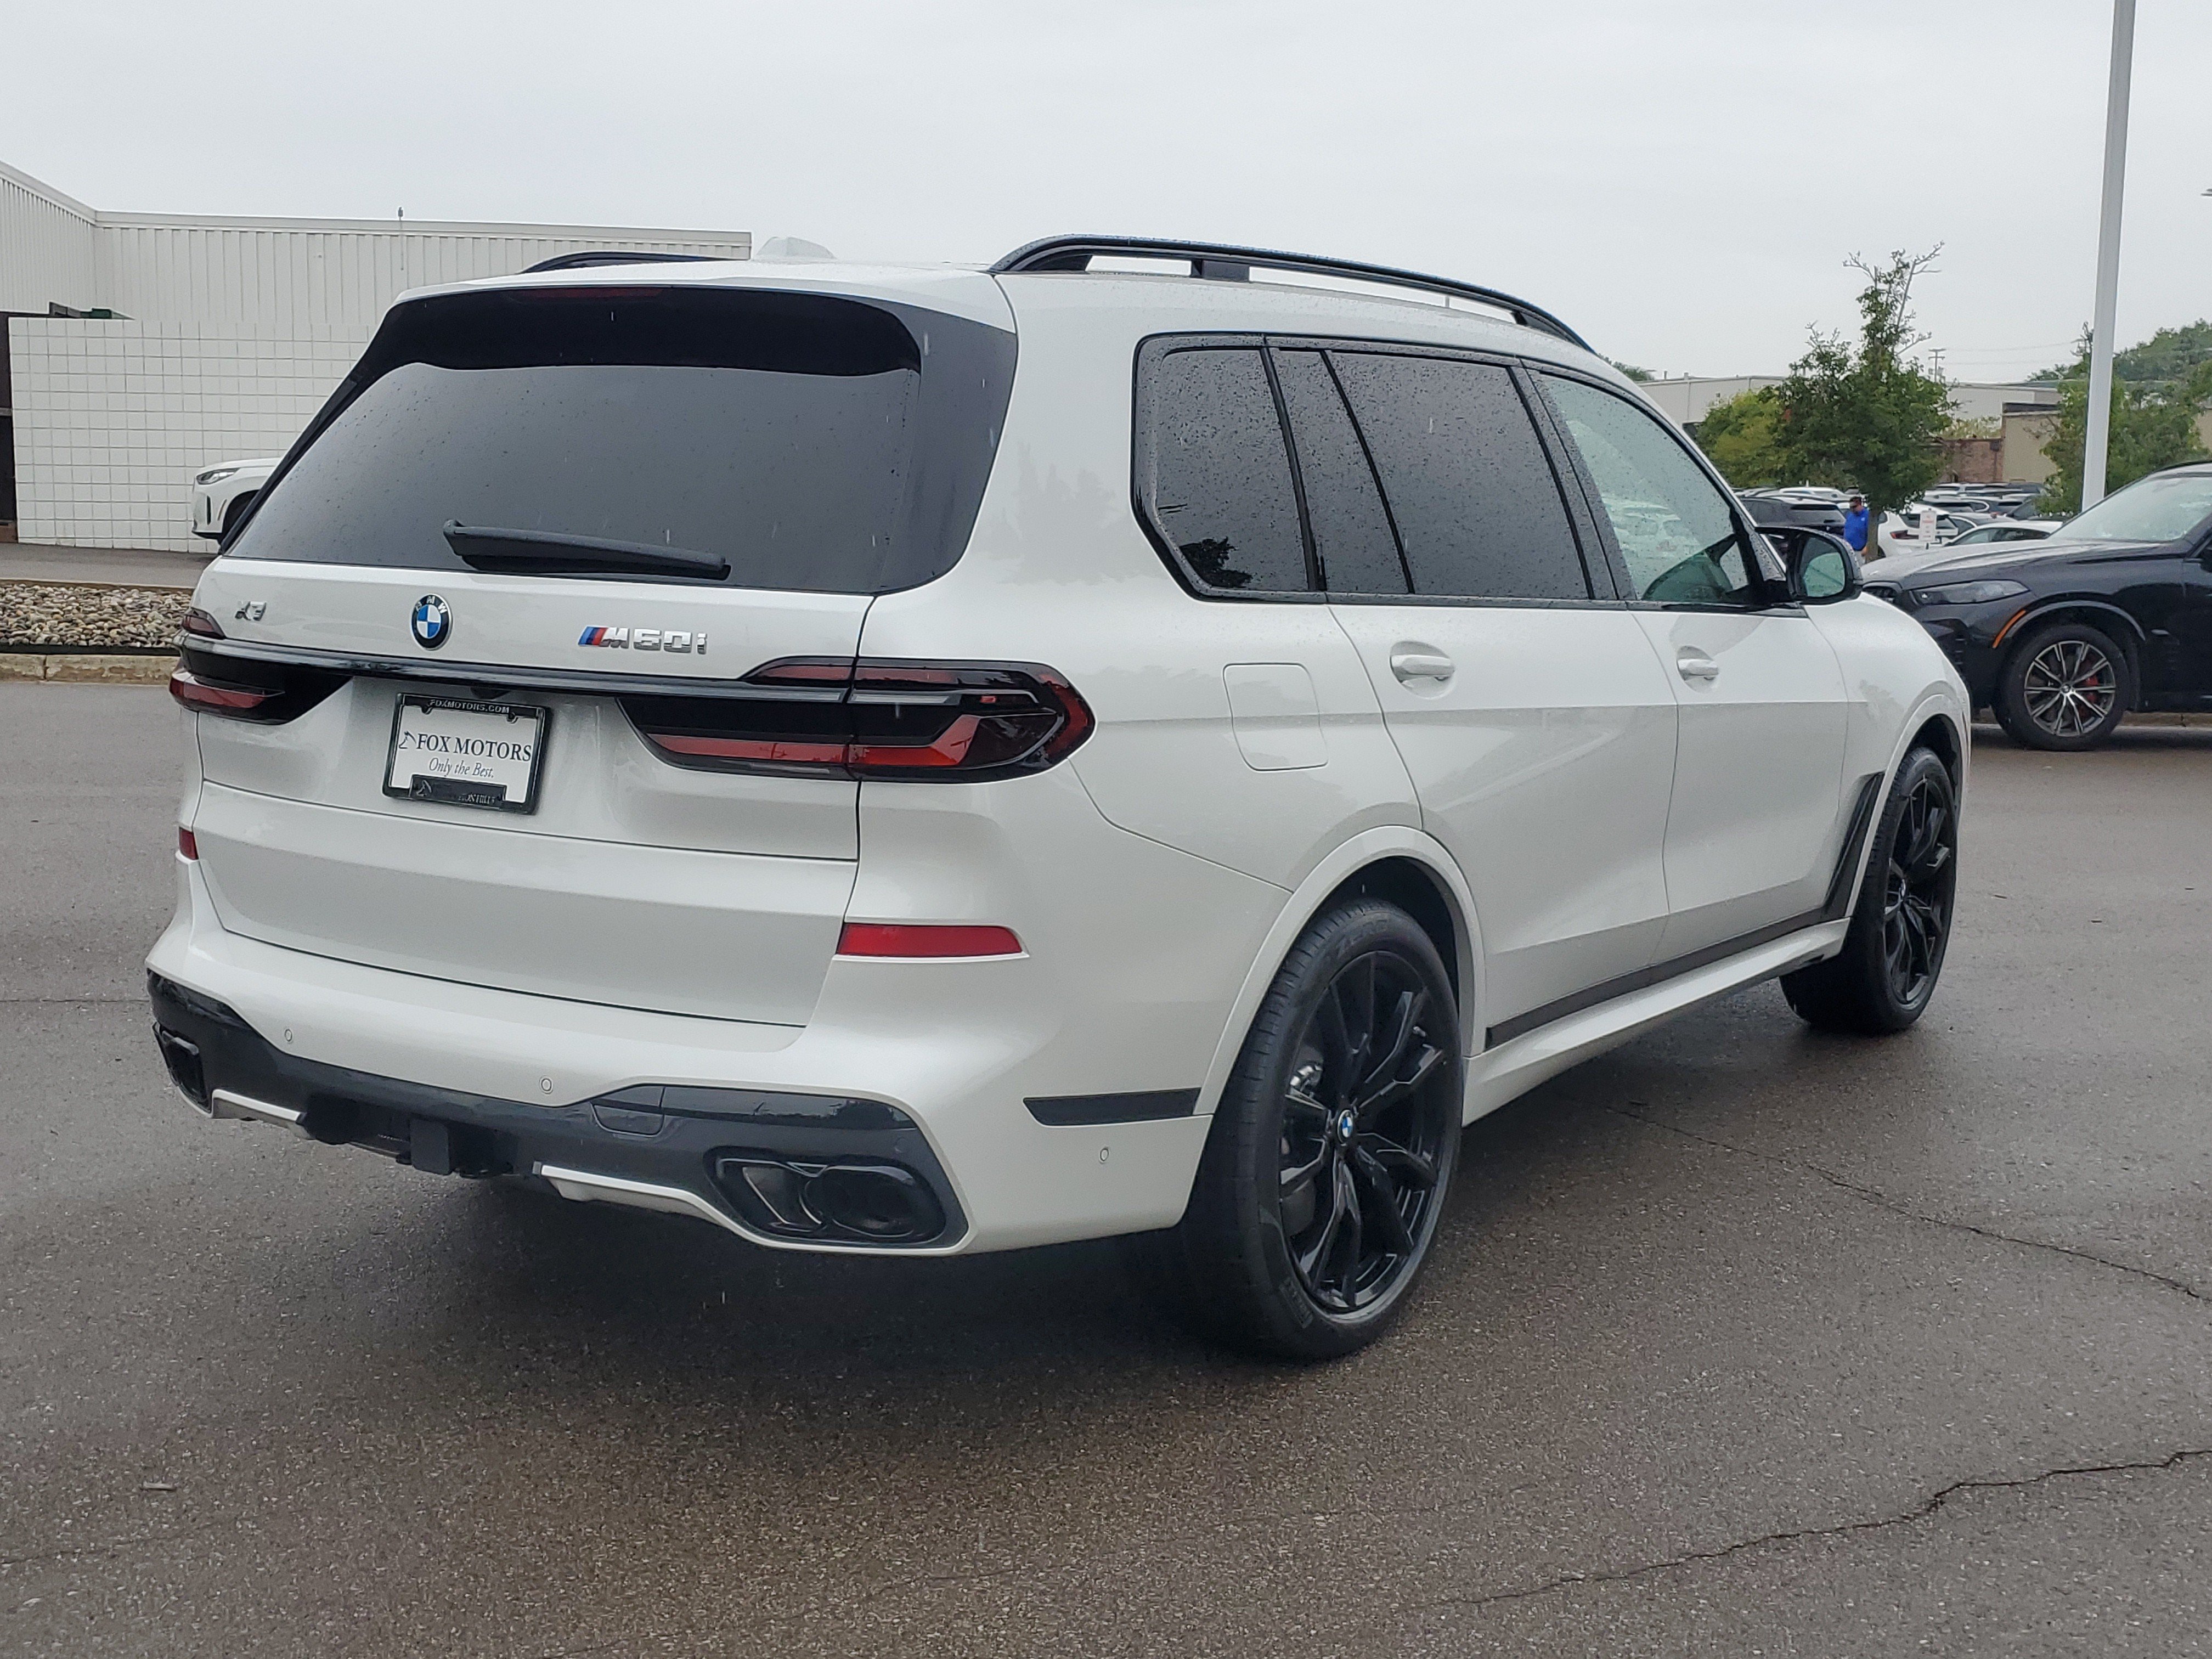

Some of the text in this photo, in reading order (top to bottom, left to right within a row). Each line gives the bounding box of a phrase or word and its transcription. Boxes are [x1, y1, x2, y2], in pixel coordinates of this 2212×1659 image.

[234, 600, 267, 622] X7
[415, 596, 448, 614] BMW
[599, 627, 707, 655] M60i
[428, 699, 510, 714] FOXMOTORS.COM
[416, 733, 532, 761] FOX MOTORS
[429, 758, 494, 778] Only the Best.
